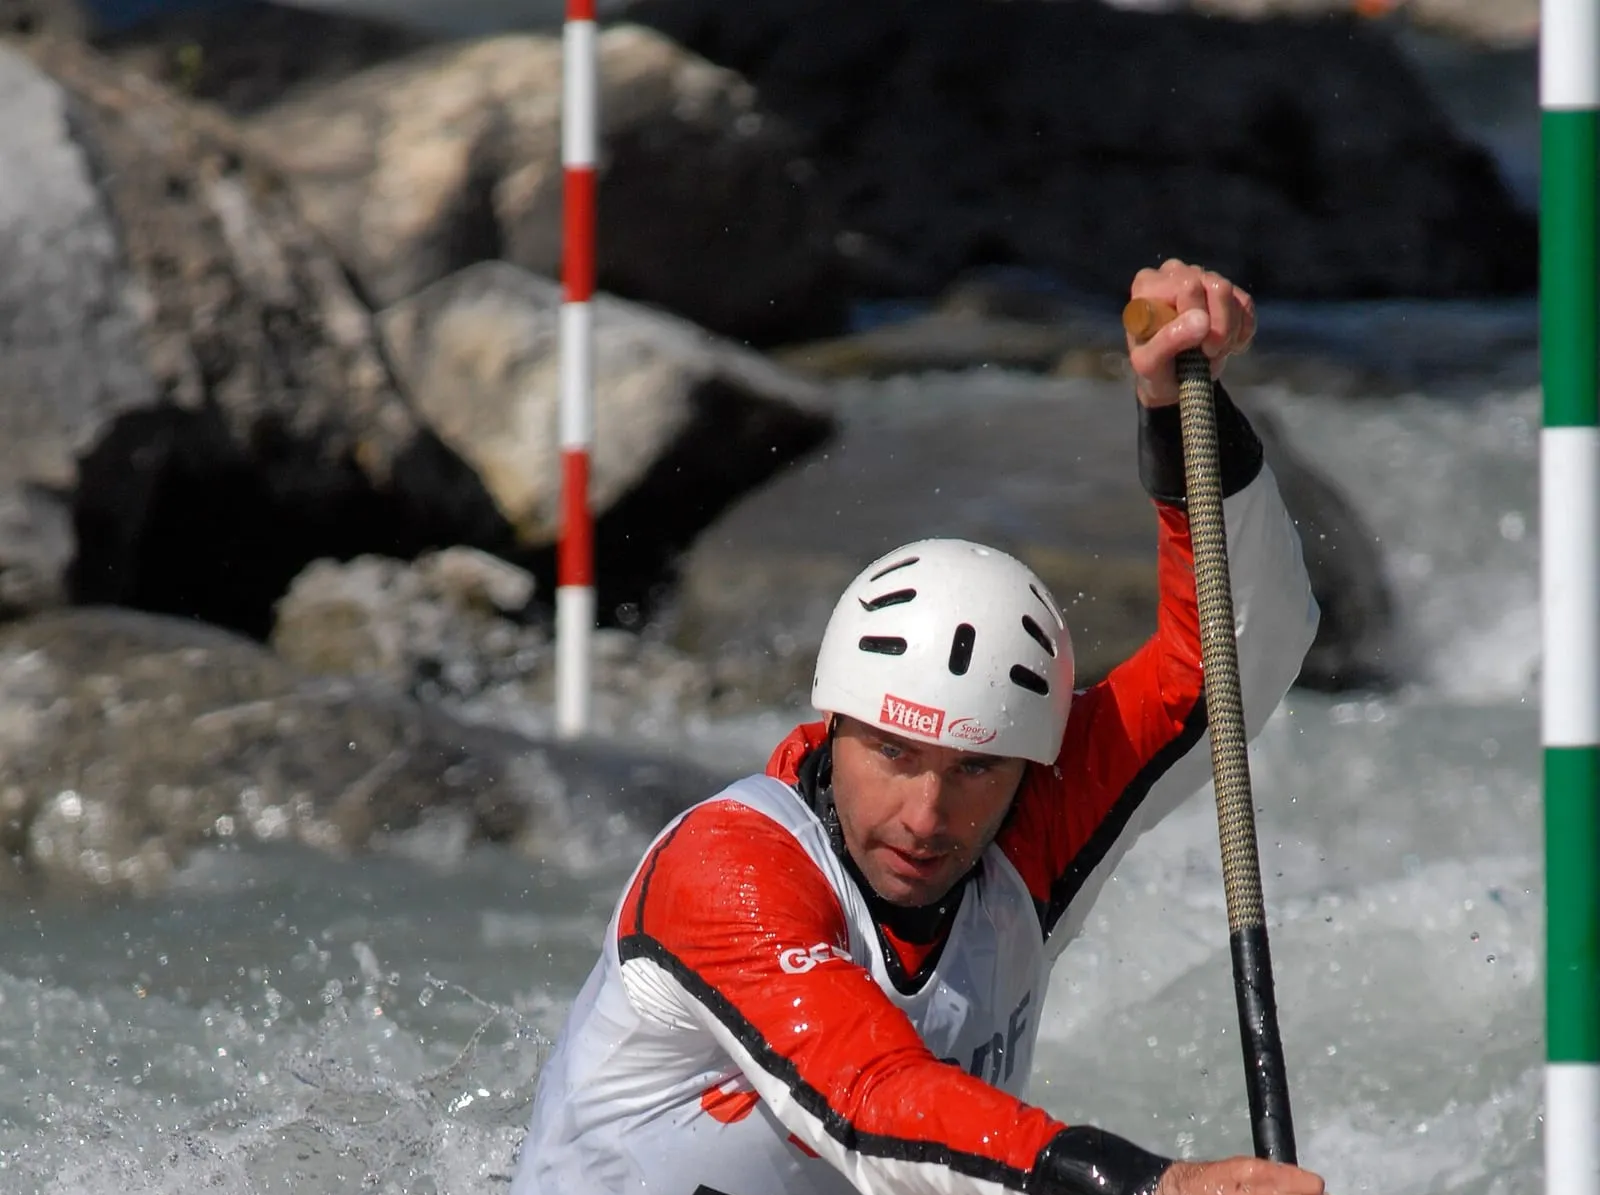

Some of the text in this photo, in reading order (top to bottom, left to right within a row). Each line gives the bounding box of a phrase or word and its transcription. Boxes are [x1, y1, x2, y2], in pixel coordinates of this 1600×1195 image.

[885, 698, 940, 734] Vittel
[960, 723, 988, 736] Sport
[938, 989, 1032, 1088] DF
